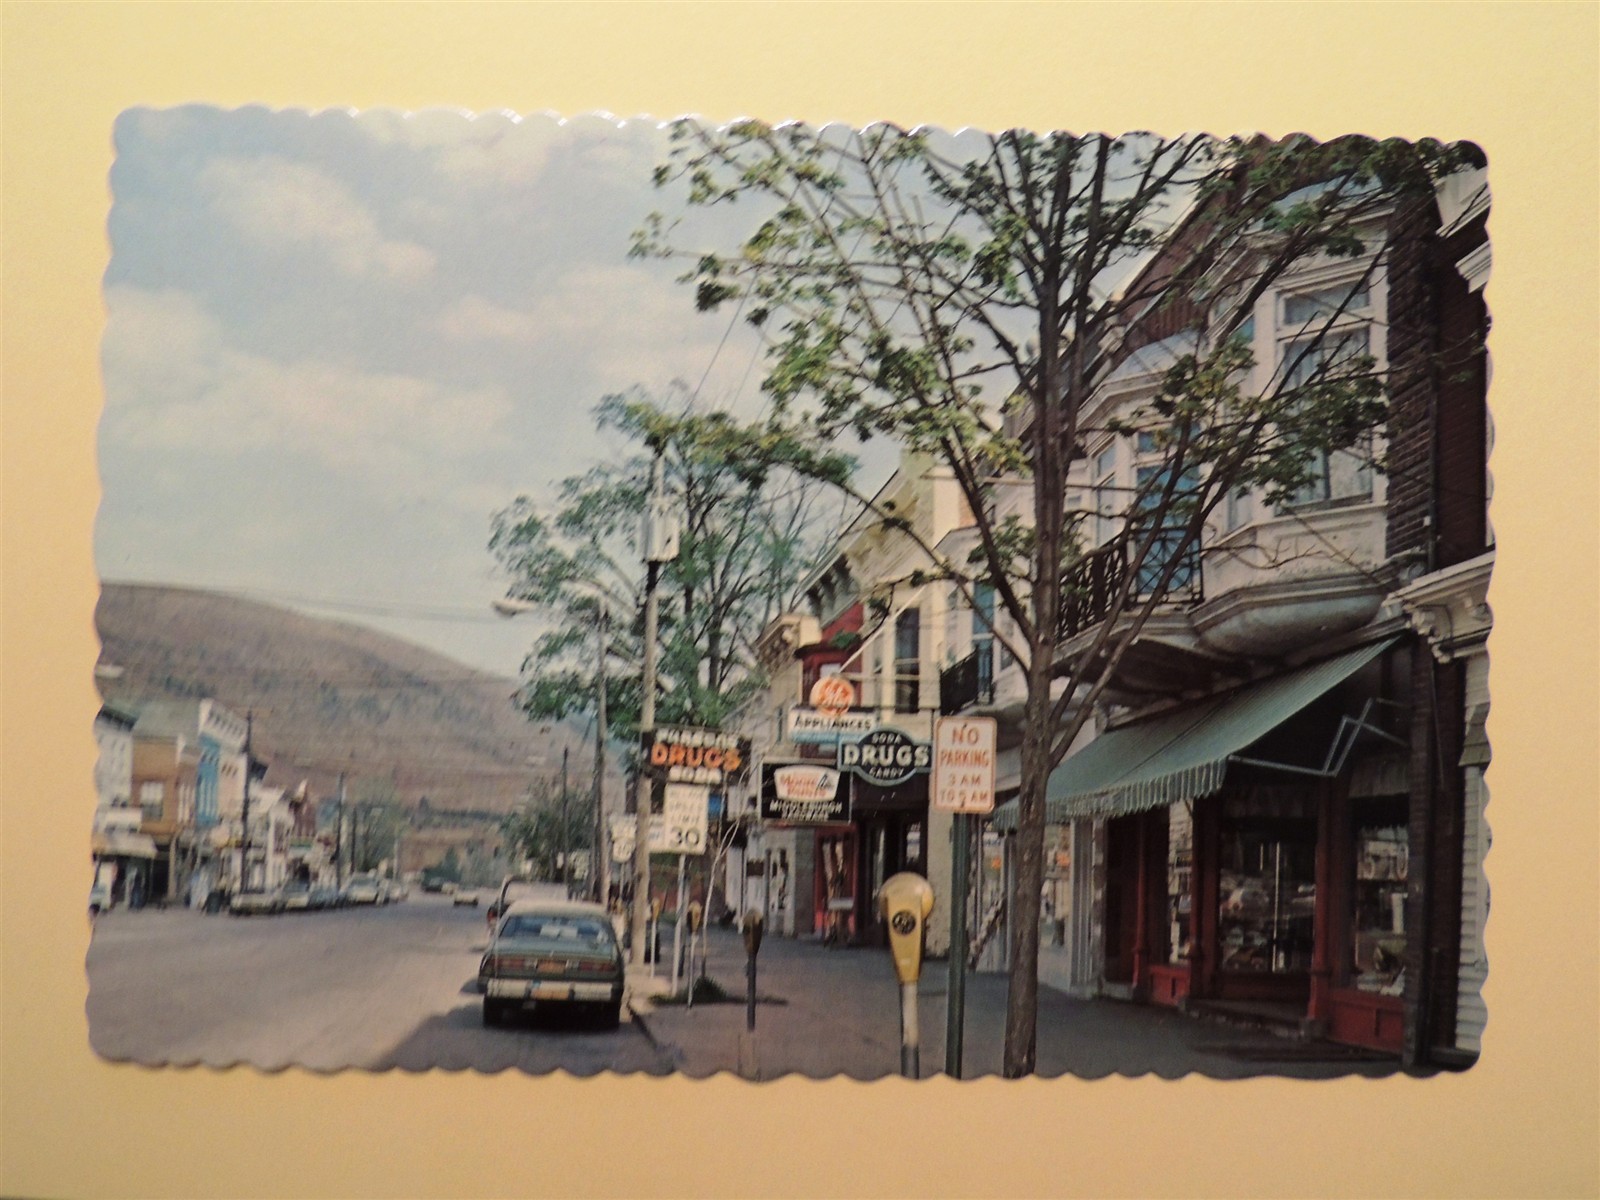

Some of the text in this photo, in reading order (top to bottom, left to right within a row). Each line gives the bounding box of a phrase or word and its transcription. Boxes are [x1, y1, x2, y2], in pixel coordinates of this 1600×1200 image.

[794, 714, 872, 730] APPLIANCES
[871, 732, 902, 744] SODA
[952, 727, 979, 745] NO
[651, 743, 741, 772] DRUGS
[843, 743, 929, 768] DRUGS
[940, 750, 989, 767] PARKING
[961, 775, 981, 785] AM
[971, 791, 988, 802] AM
[670, 826, 700, 846] 30
